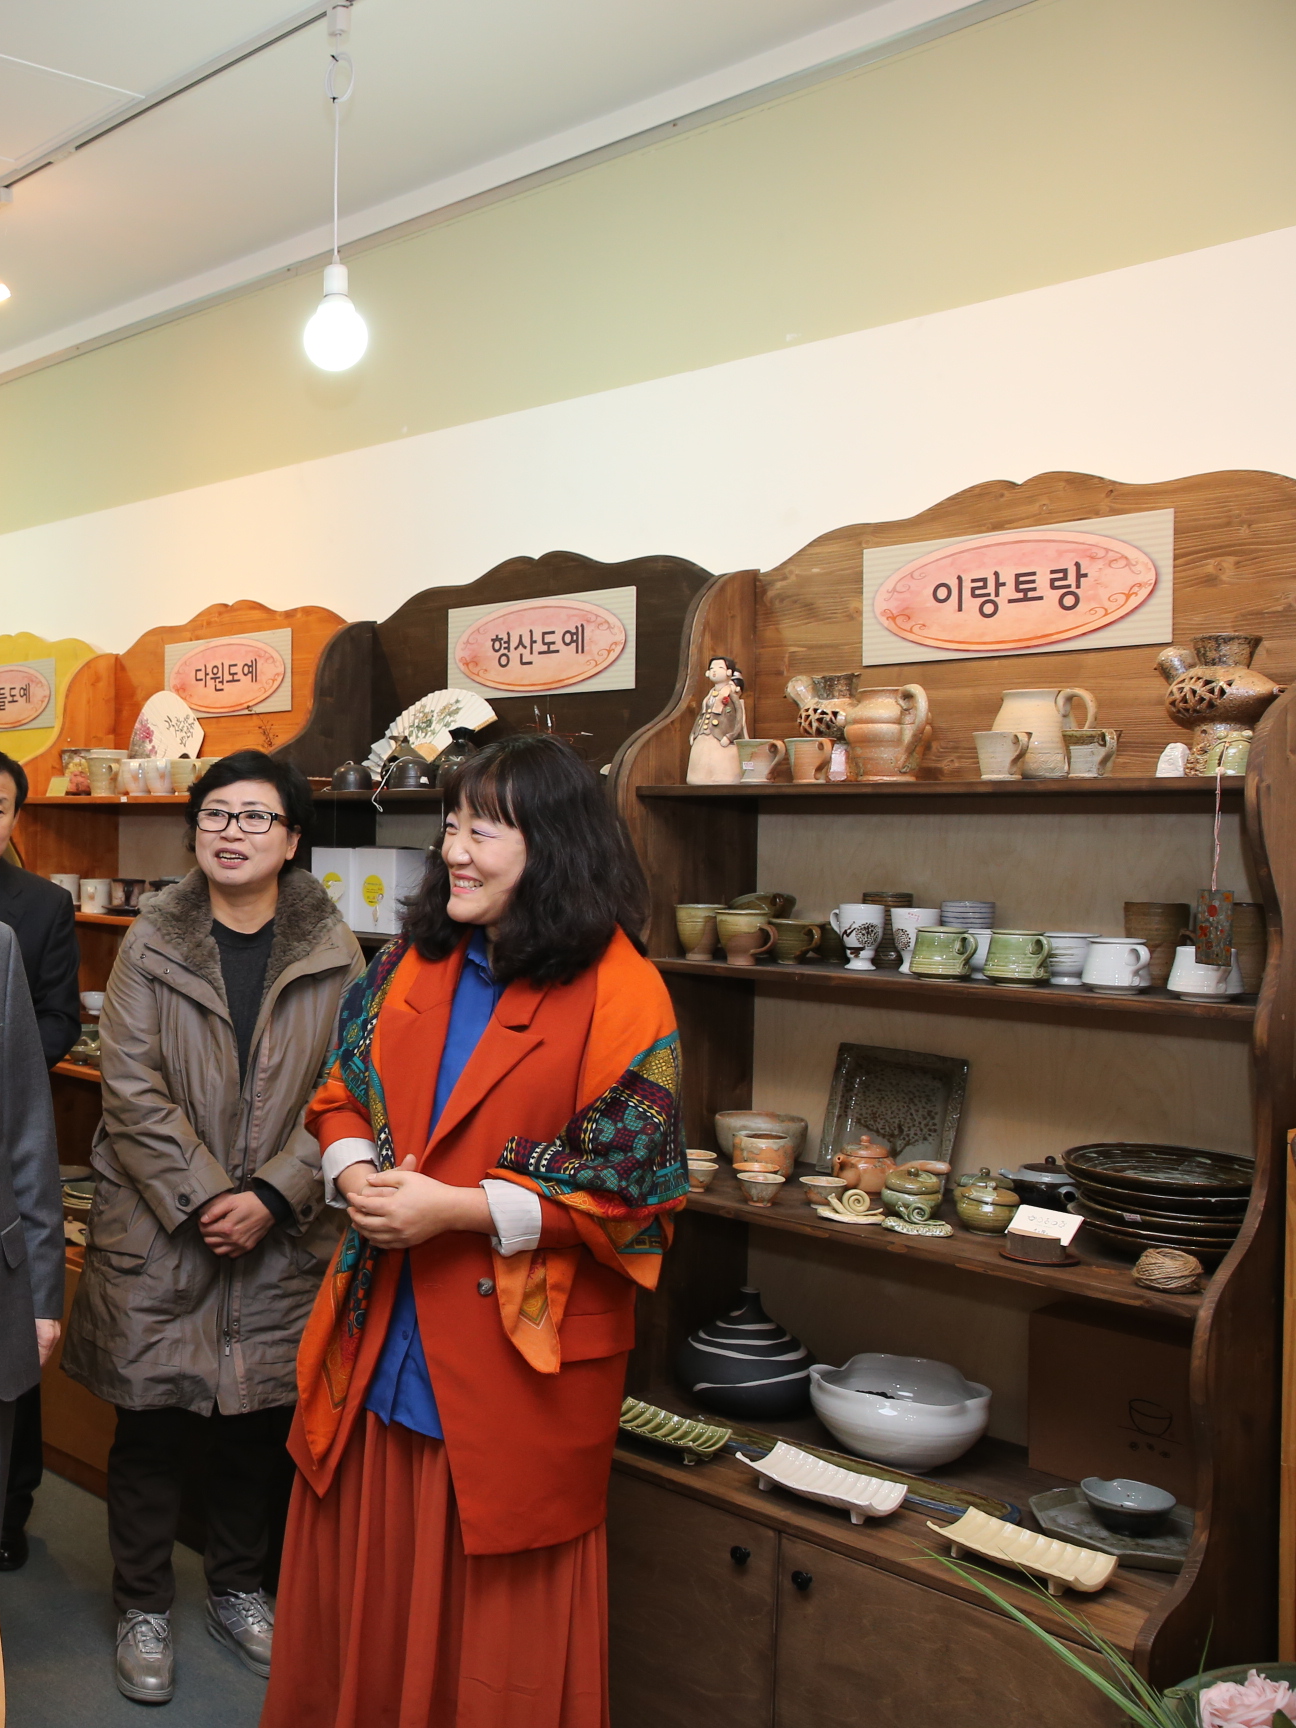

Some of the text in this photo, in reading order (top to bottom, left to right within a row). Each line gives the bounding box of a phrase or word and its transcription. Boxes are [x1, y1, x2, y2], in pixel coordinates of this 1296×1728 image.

[932, 561, 1088, 618] 이랑토랑
[491, 623, 585, 668] 형산도예
[195, 658, 258, 692] 다원도예
